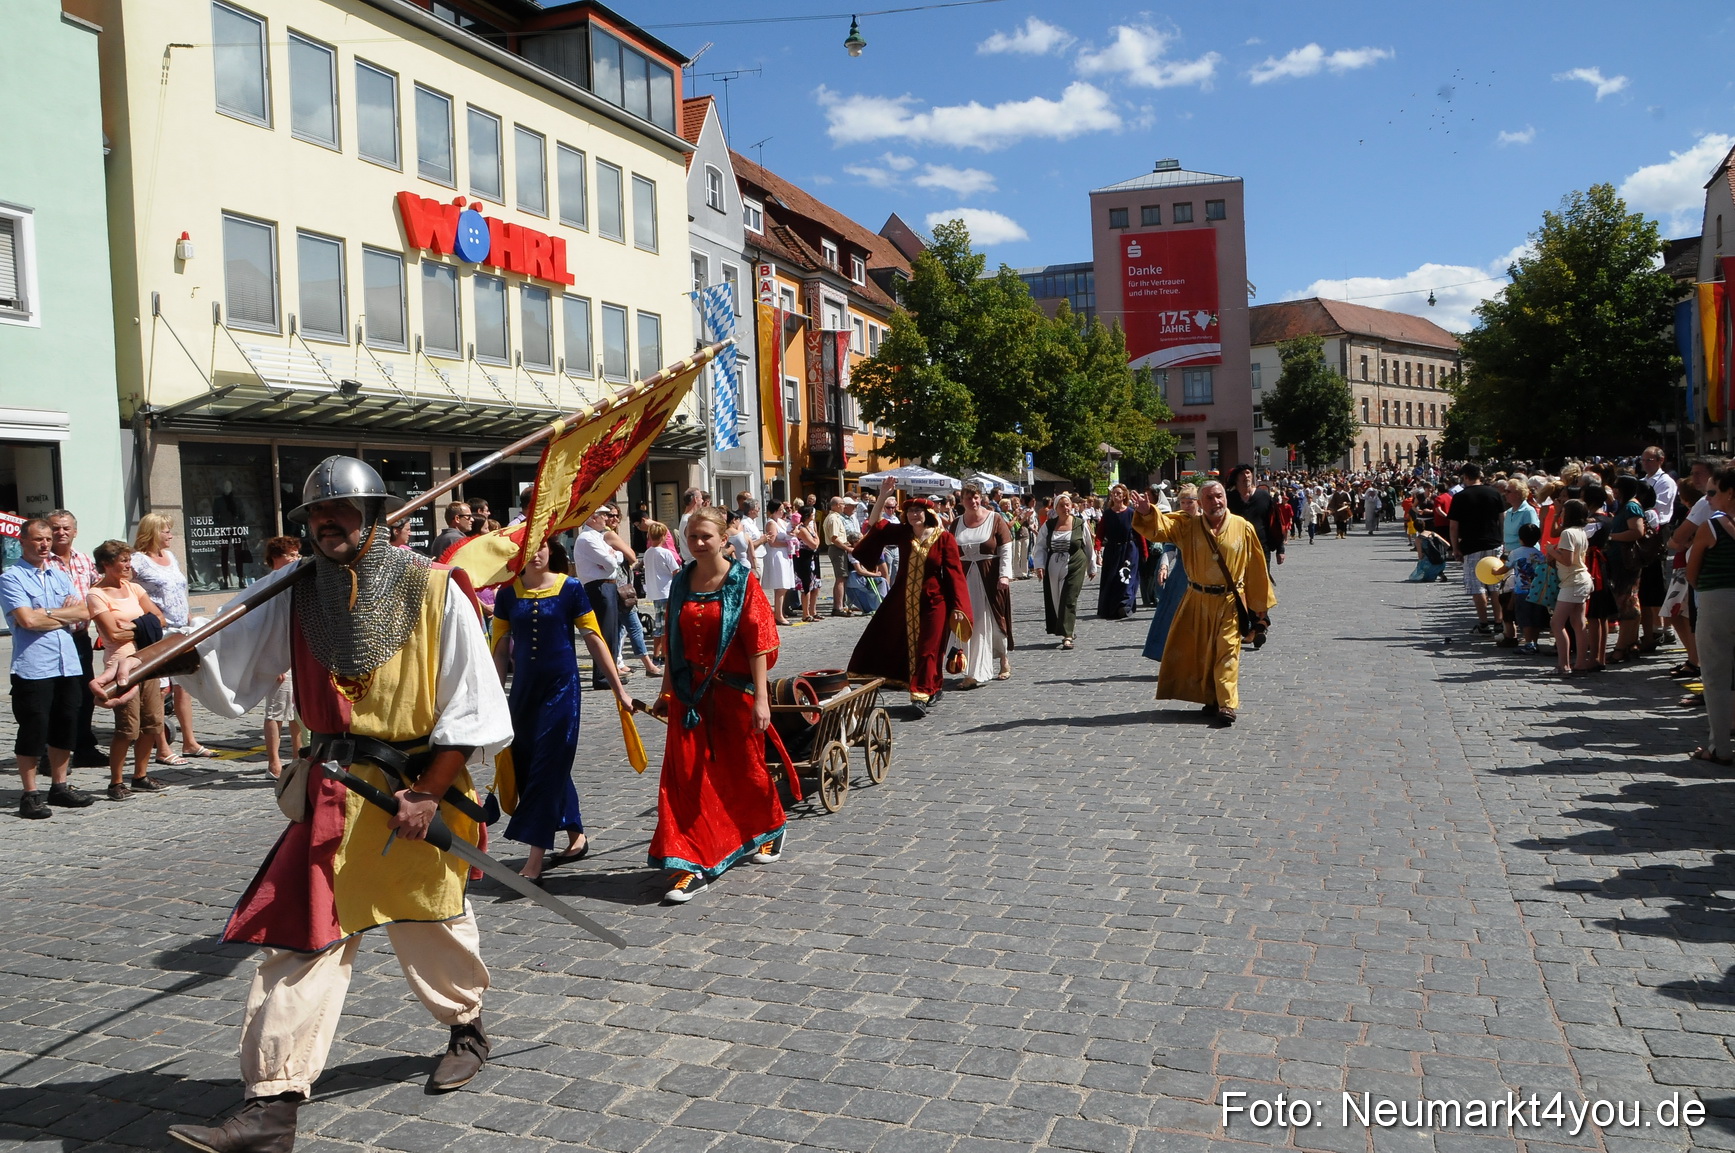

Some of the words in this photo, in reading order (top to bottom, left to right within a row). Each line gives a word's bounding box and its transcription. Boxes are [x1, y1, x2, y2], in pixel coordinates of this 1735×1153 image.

[397, 191, 575, 286] WÖHRL
[1128, 265, 1163, 276] Danke
[1128, 280, 1139, 288] für
[1128, 289, 1143, 297] und
[1158, 310, 1191, 325] 175
[1160, 324, 1191, 334] JAHRE
[190, 516, 214, 525] NEUE
[191, 526, 249, 537] KOLLEKTION
